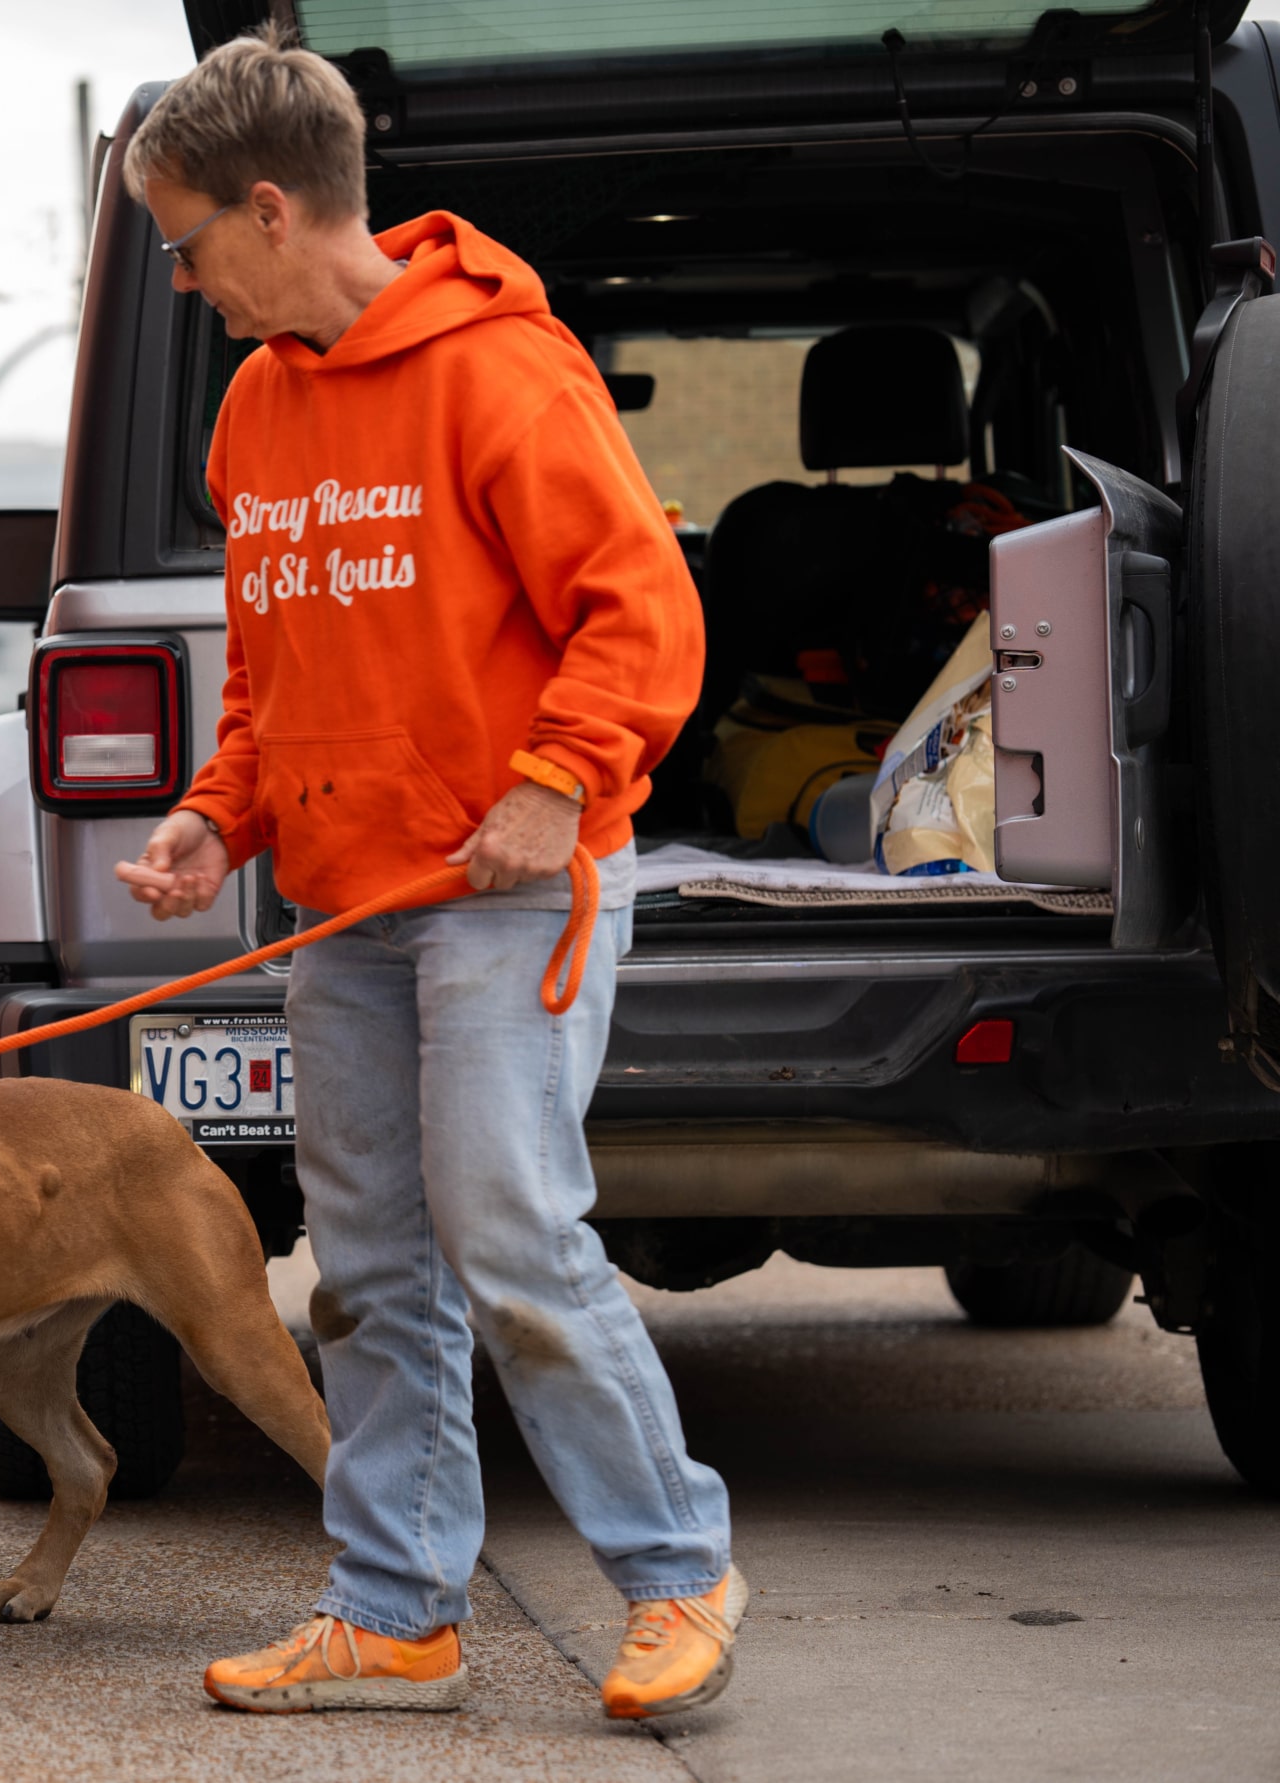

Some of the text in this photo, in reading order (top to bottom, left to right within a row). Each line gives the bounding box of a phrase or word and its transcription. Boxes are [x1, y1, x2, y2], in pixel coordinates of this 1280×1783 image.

[230, 492, 309, 542] Stray
[242, 544, 416, 615] of St. Louis
[145, 1047, 241, 1111] VG3
[200, 1125, 236, 1137] Can't
[239, 1125, 270, 1136] Beat
[273, 1126, 282, 1136] a
